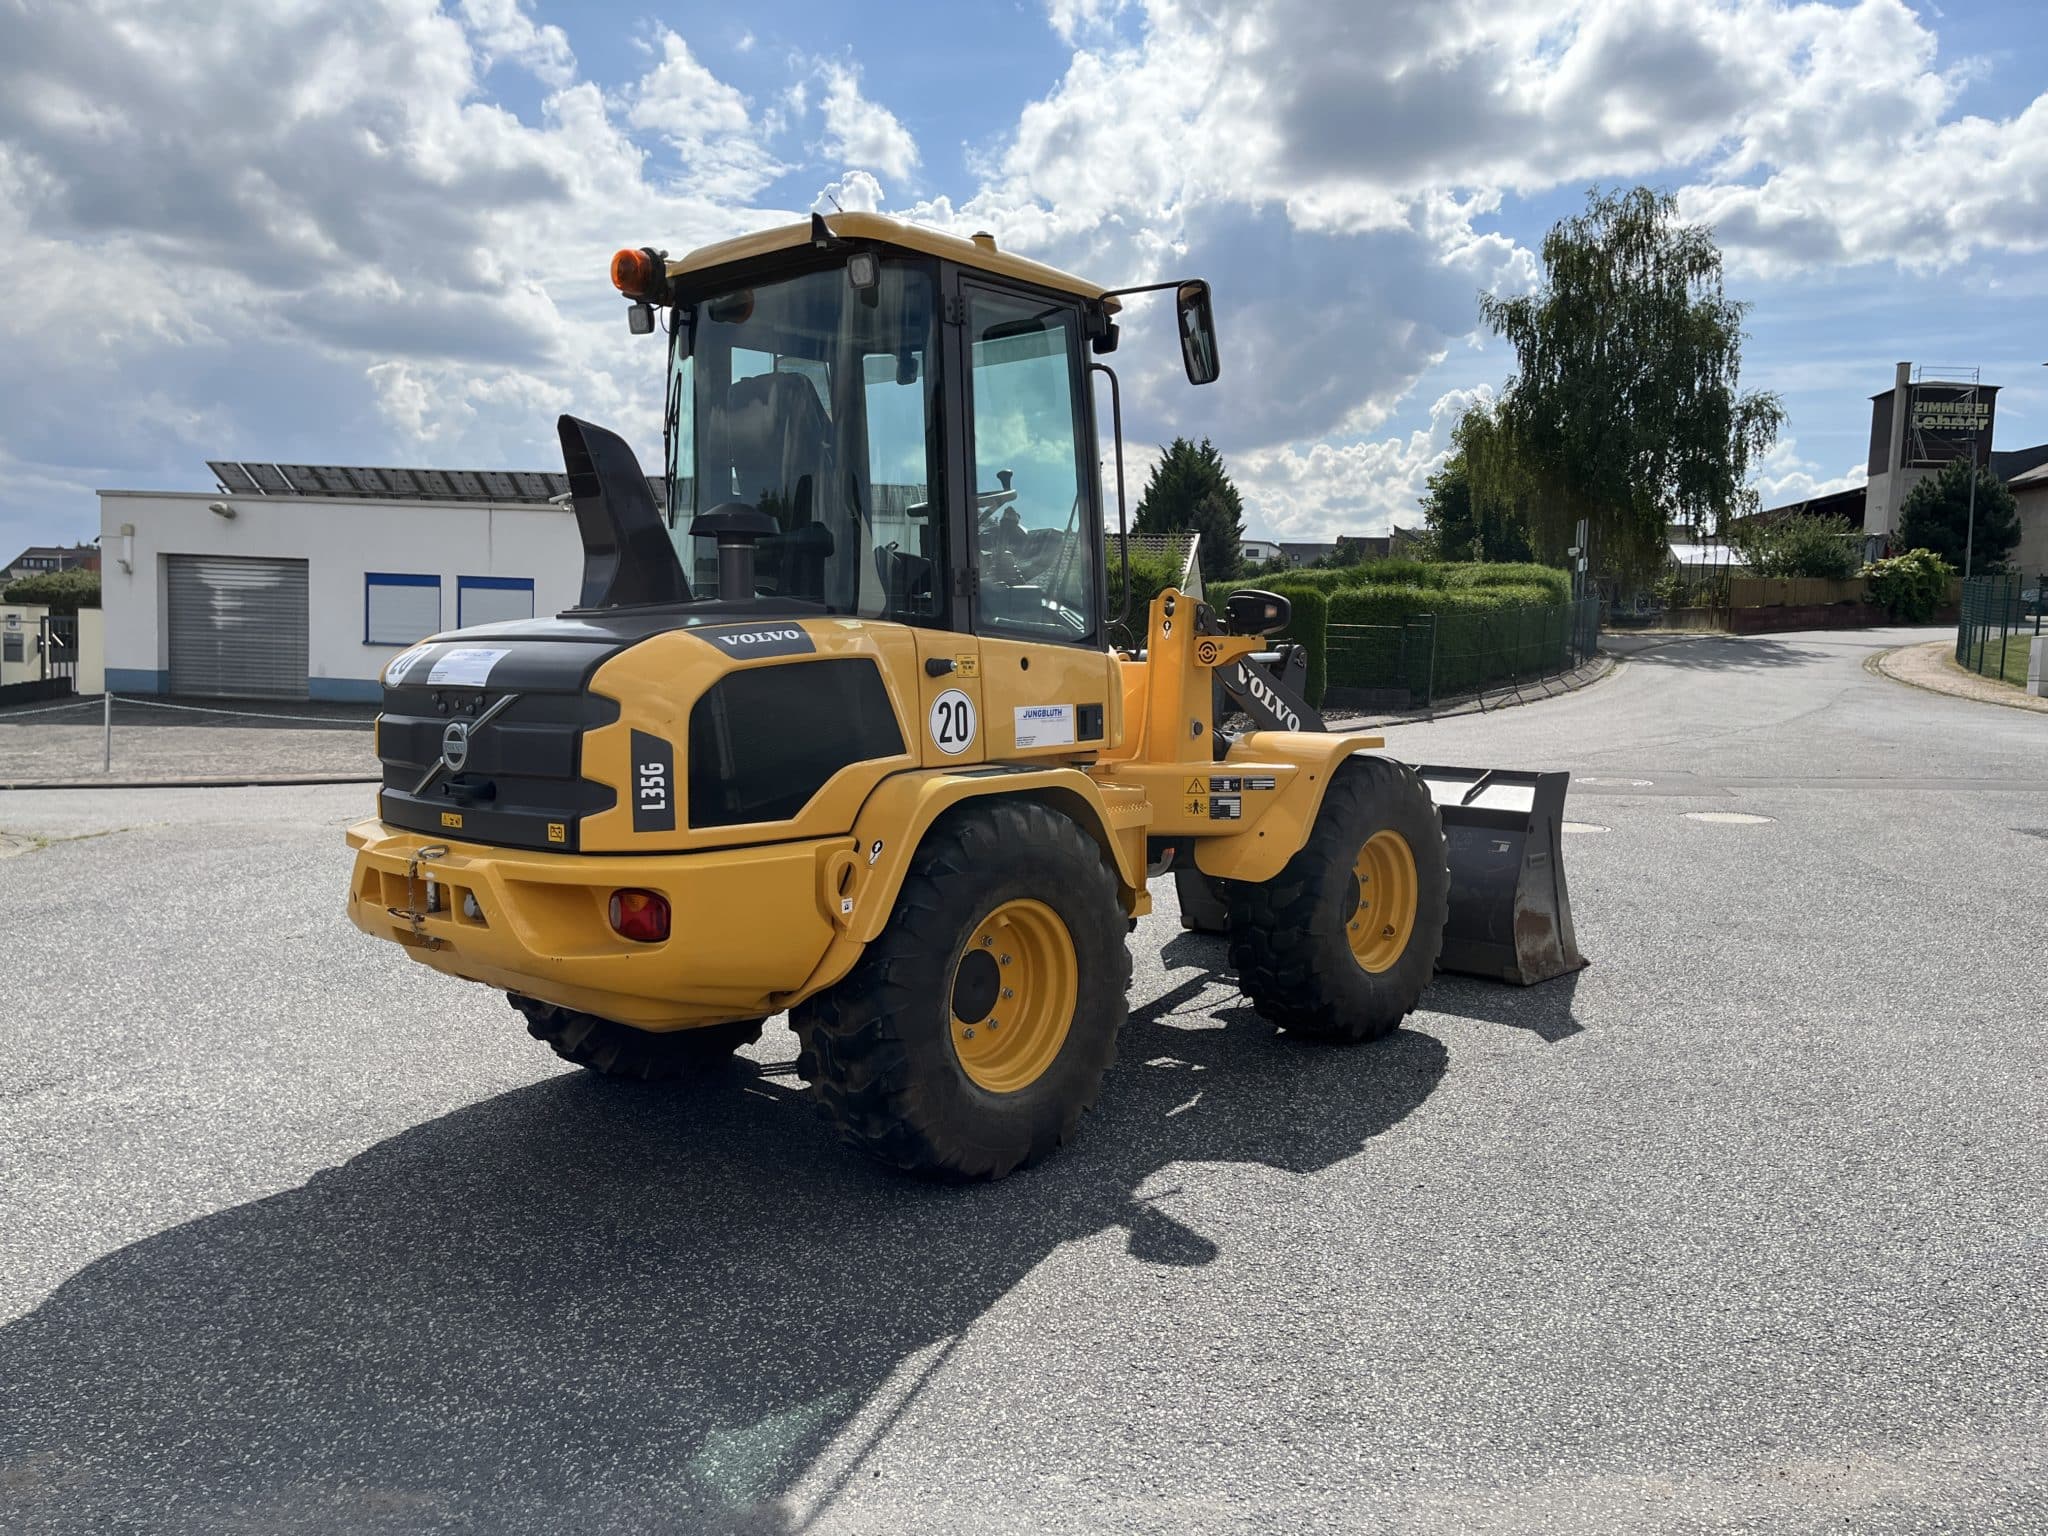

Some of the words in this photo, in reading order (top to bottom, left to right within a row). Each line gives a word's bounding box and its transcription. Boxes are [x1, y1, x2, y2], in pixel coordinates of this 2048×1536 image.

[1914, 402, 1989, 414] ZIMMEREI
[718, 629, 800, 646] VOLVO
[1238, 663, 1300, 732] VOLVO
[938, 701, 968, 743] 20
[1023, 708, 1063, 718] JUNGBLUTH
[640, 762, 666, 810] L35G
